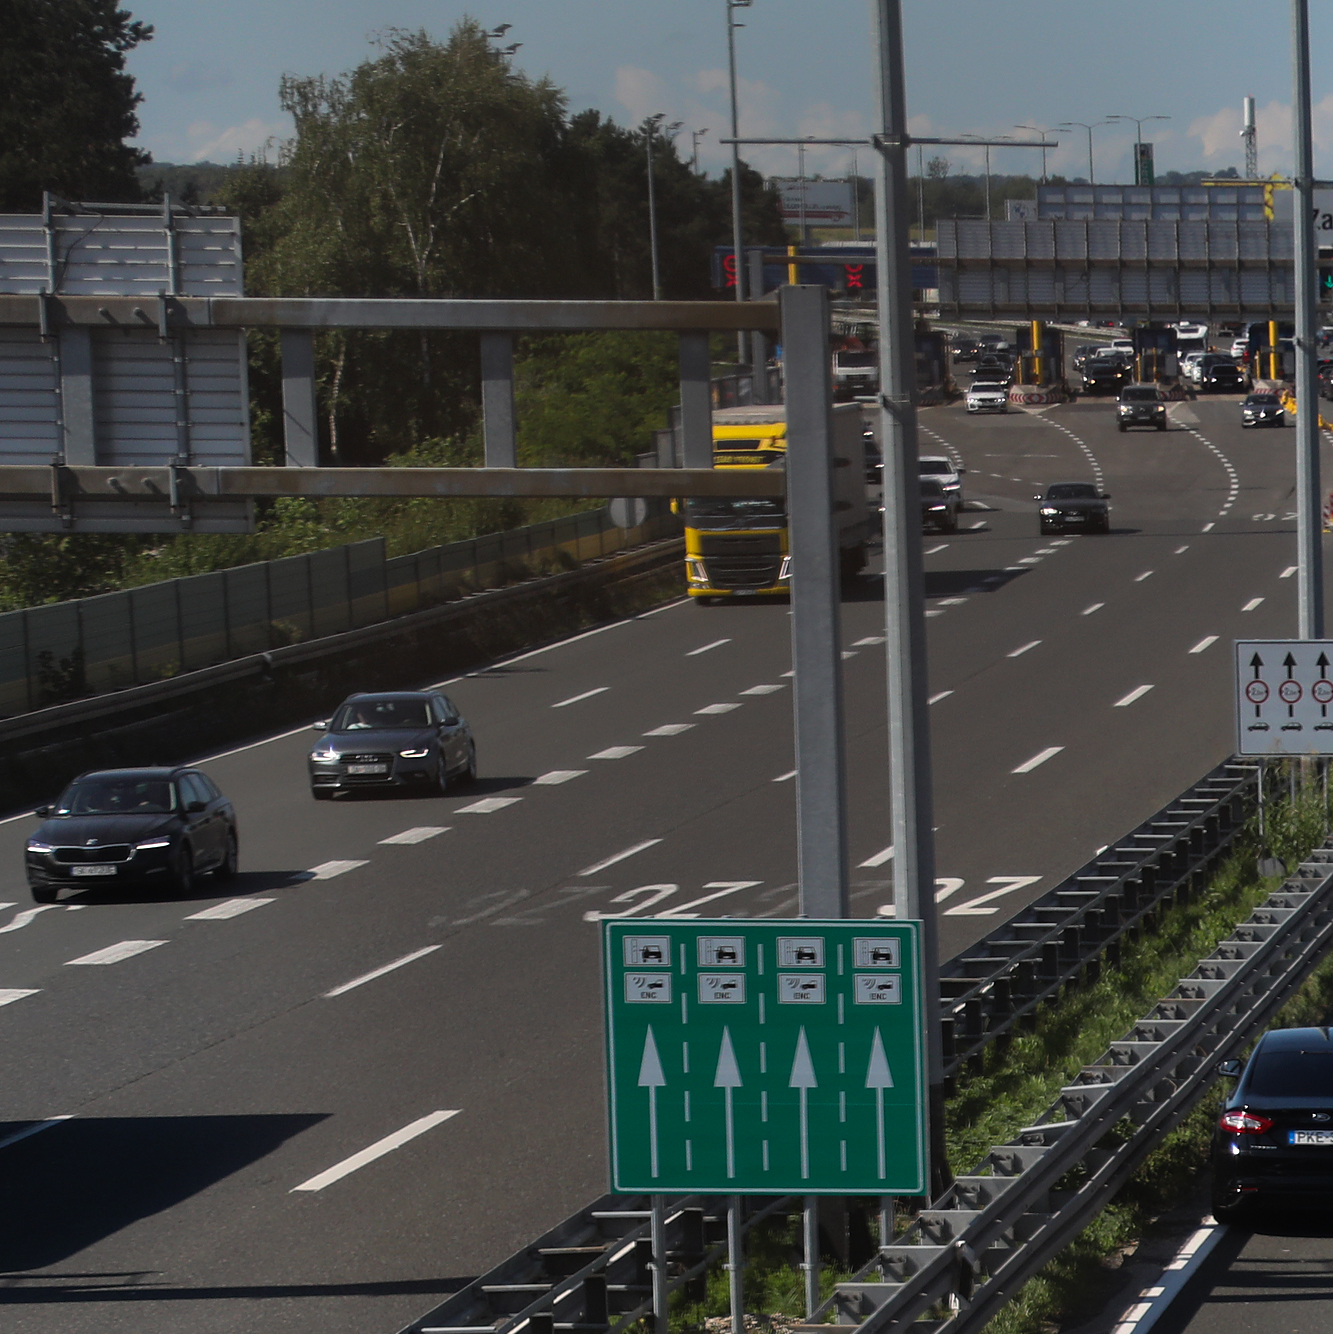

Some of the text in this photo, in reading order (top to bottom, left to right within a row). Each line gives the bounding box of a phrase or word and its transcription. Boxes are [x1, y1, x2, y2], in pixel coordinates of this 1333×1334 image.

[641, 991, 657, 999] ENC
[714, 991, 731, 999] ENC
[794, 992, 811, 1000] ENC
[870, 992, 887, 1001] ENC
